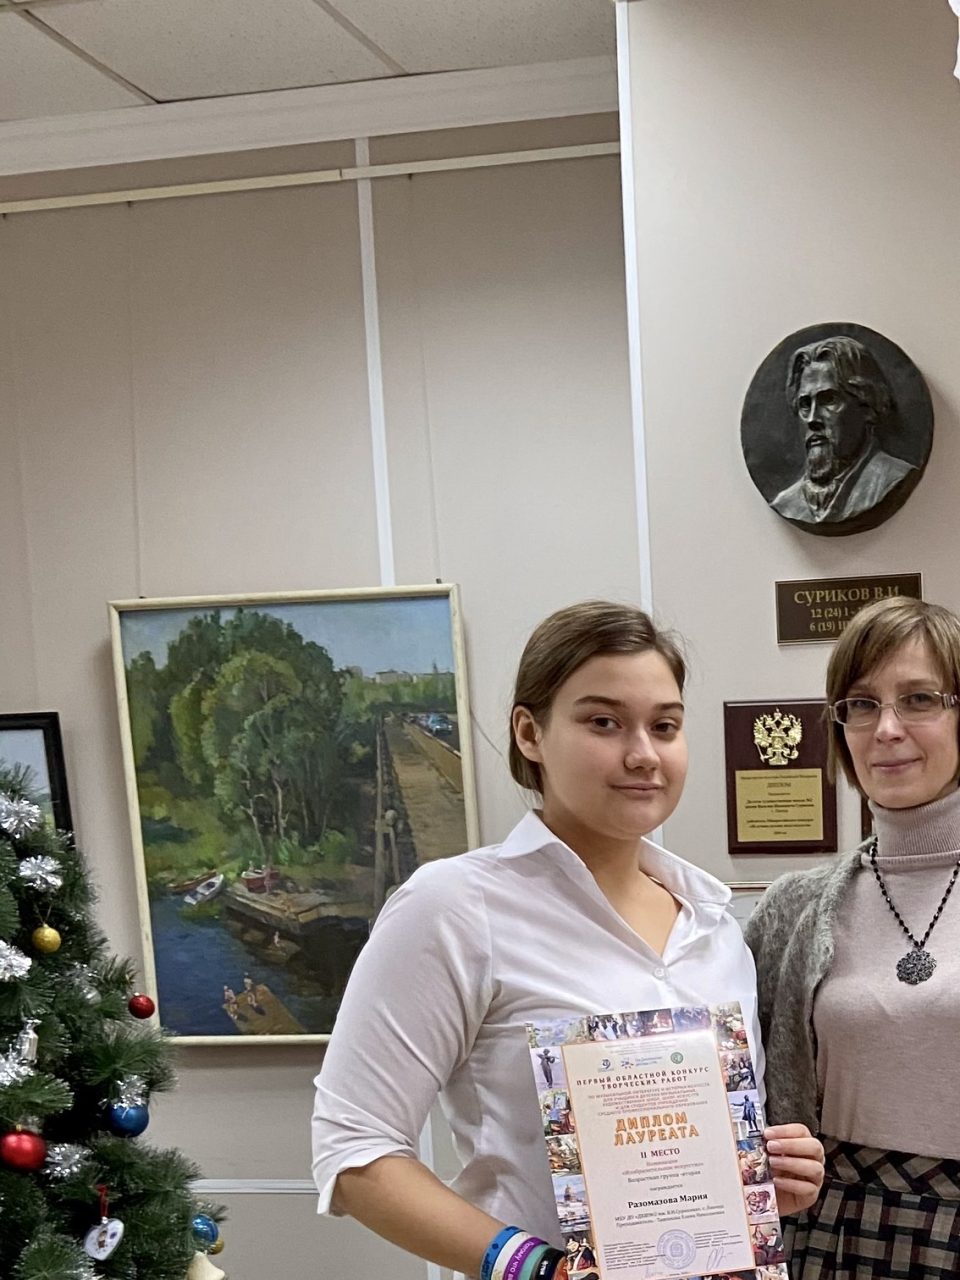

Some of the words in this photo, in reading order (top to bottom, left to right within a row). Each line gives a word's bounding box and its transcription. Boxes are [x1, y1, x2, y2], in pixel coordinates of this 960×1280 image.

[794, 588, 869, 606] СУРИКОВ
[811, 609, 822, 618] 12
[824, 607, 842, 619] (24)
[809, 623, 816, 632] 6
[818, 622, 836, 633] (19)
[575, 1076, 611, 1085] ПЕРВЫЙ
[615, 1070, 666, 1081] ОБЛАСТНОЙ
[670, 1065, 709, 1075] КОНКУРС
[601, 1079, 657, 1089] ТВОРЧЕСКИХ
[661, 1075, 687, 1083] РАБОТ
[613, 1111, 688, 1132] ДИПЛОМ
[612, 1124, 699, 1146] ЛАУРЕАТА
[650, 1147, 680, 1157] МЕСТО
[627, 1196, 678, 1209] Разомазова
[678, 1192, 708, 1203] Мария
[515, 1241, 535, 1260] Потому
[510, 1261, 519, 1272] что
